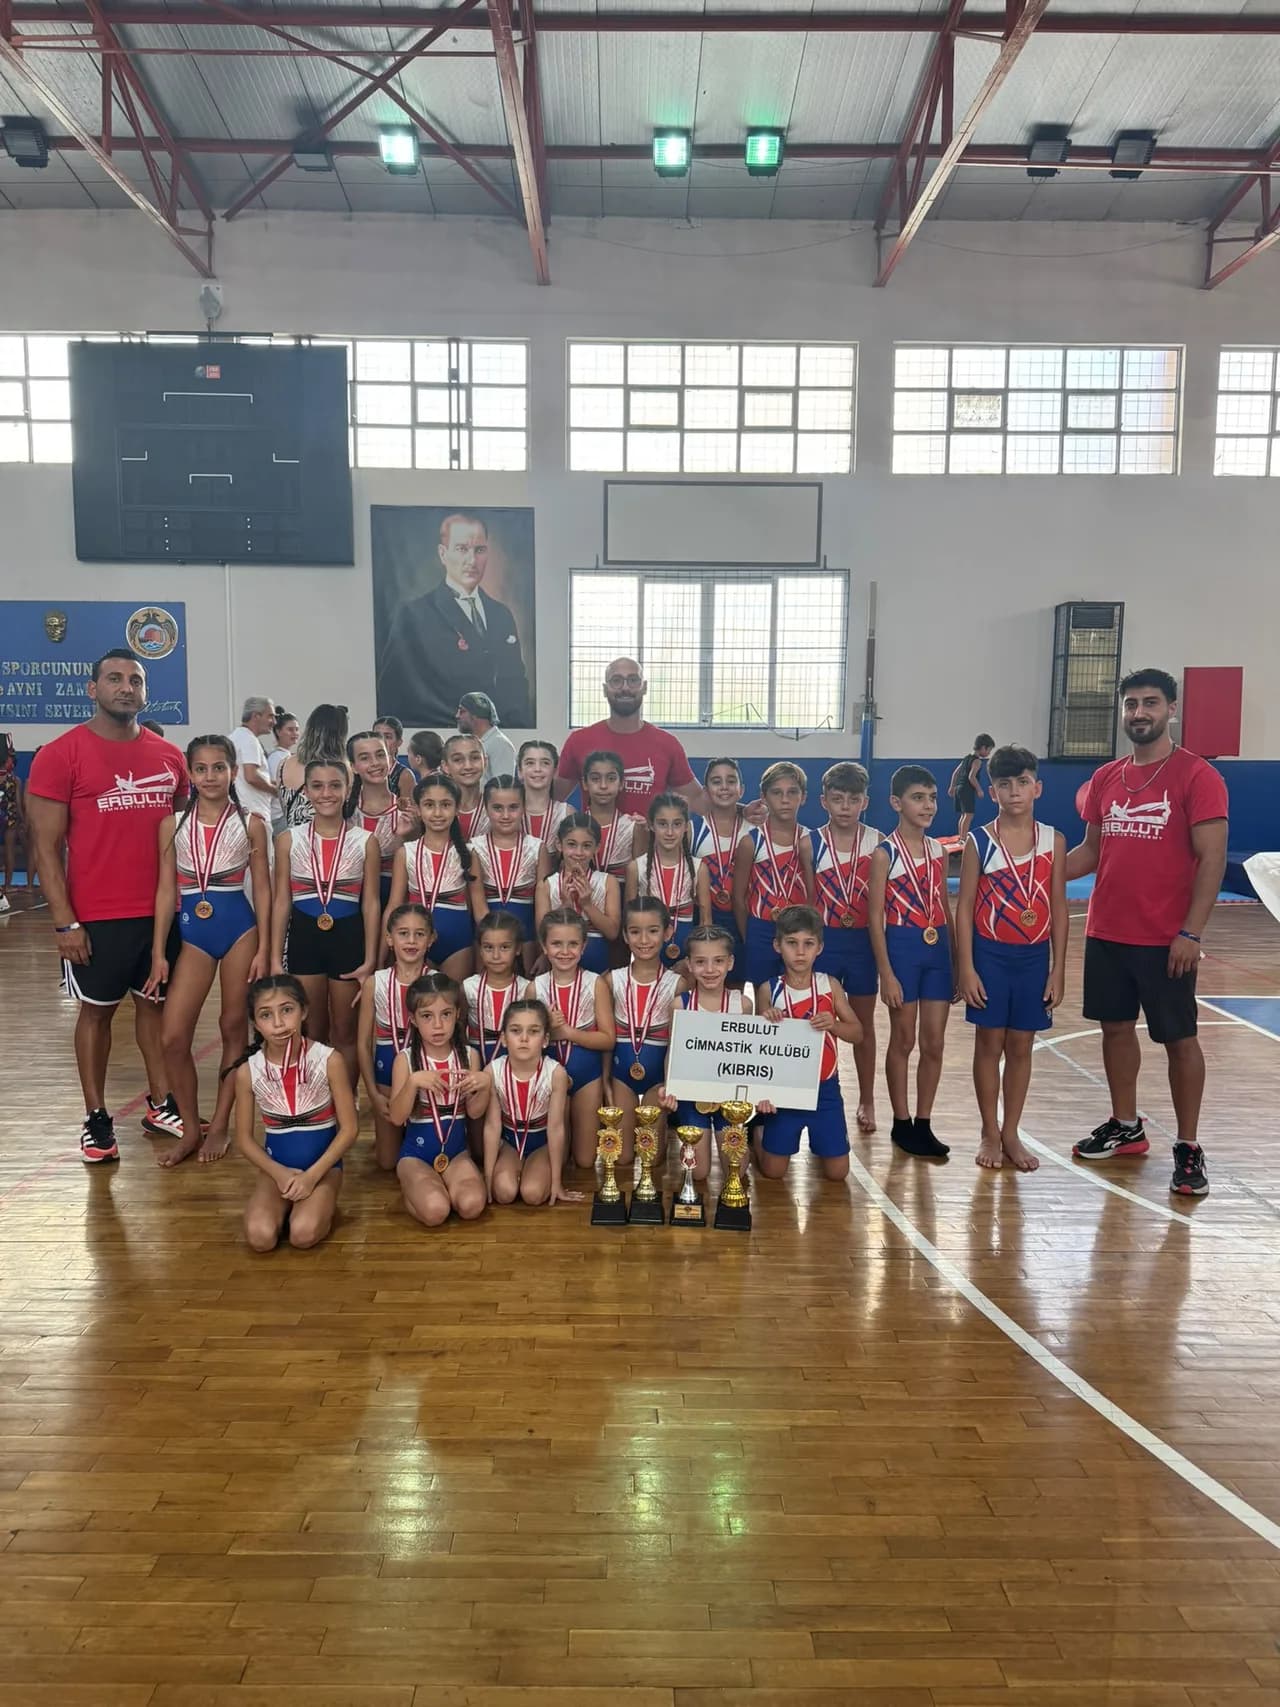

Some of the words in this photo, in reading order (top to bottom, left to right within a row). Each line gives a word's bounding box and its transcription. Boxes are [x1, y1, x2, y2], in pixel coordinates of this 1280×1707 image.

[2, 661, 94, 676] SPORCUNUN
[7, 682, 43, 696] AYNI
[721, 1021, 779, 1036] ERBULUT
[685, 1037, 753, 1054] CİMNASTİK
[759, 1044, 811, 1059] KULÜBÜ
[717, 1062, 774, 1081] (KIBRIS)
